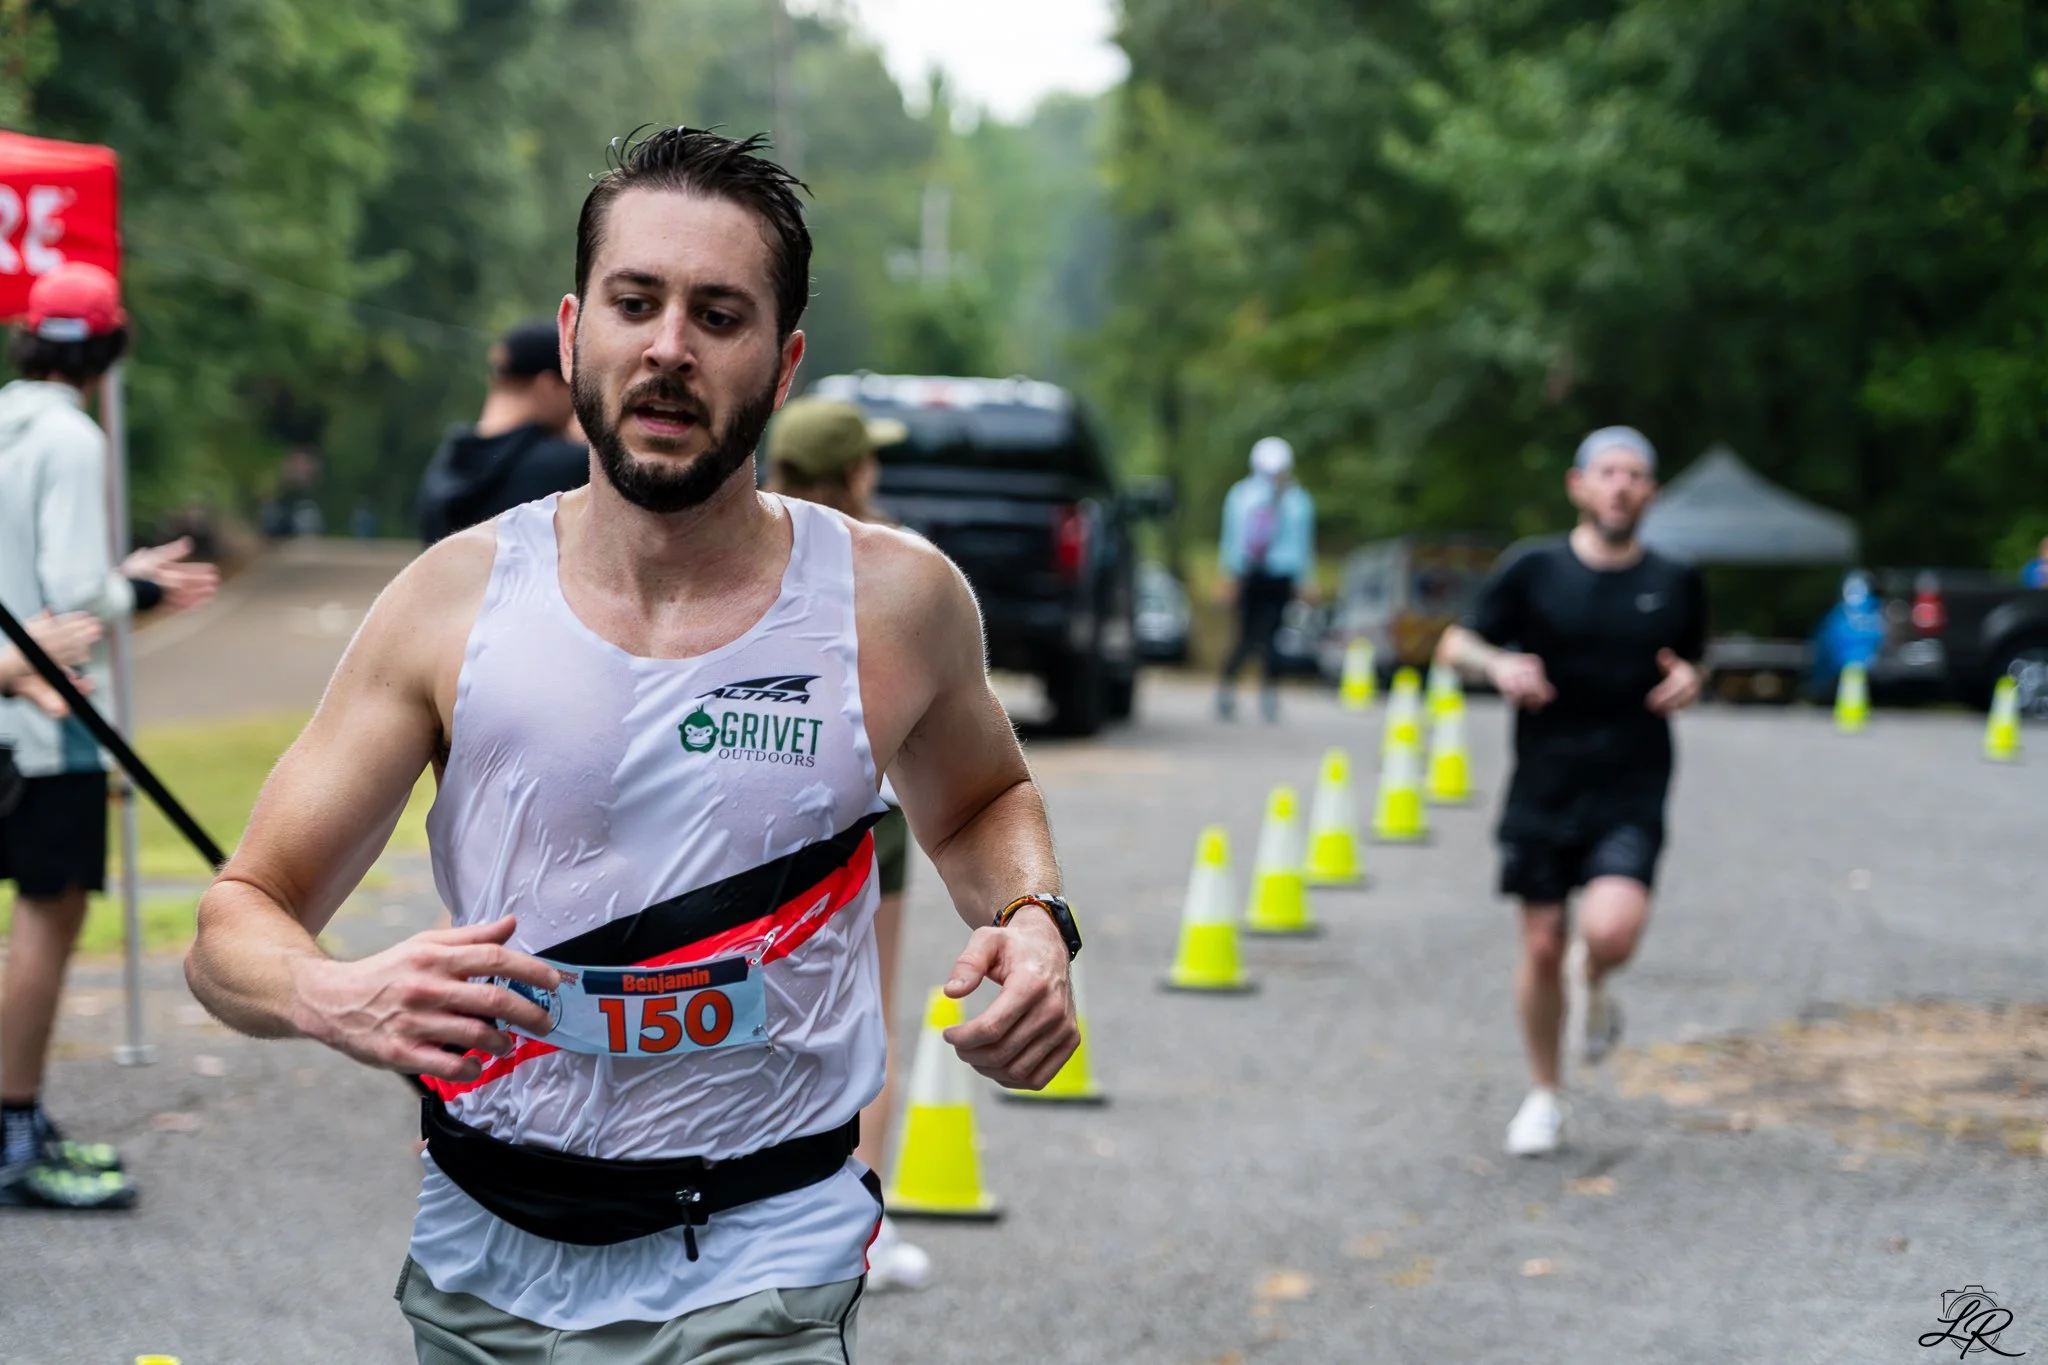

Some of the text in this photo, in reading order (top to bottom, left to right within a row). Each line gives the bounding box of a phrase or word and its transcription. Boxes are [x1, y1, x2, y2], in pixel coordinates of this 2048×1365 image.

[694, 687, 811, 705] ALTRA
[720, 711, 824, 756] GRIVET
[718, 747, 816, 768] OUTDOORS
[621, 968, 711, 994] Benjamin
[598, 989, 734, 1054] 150
